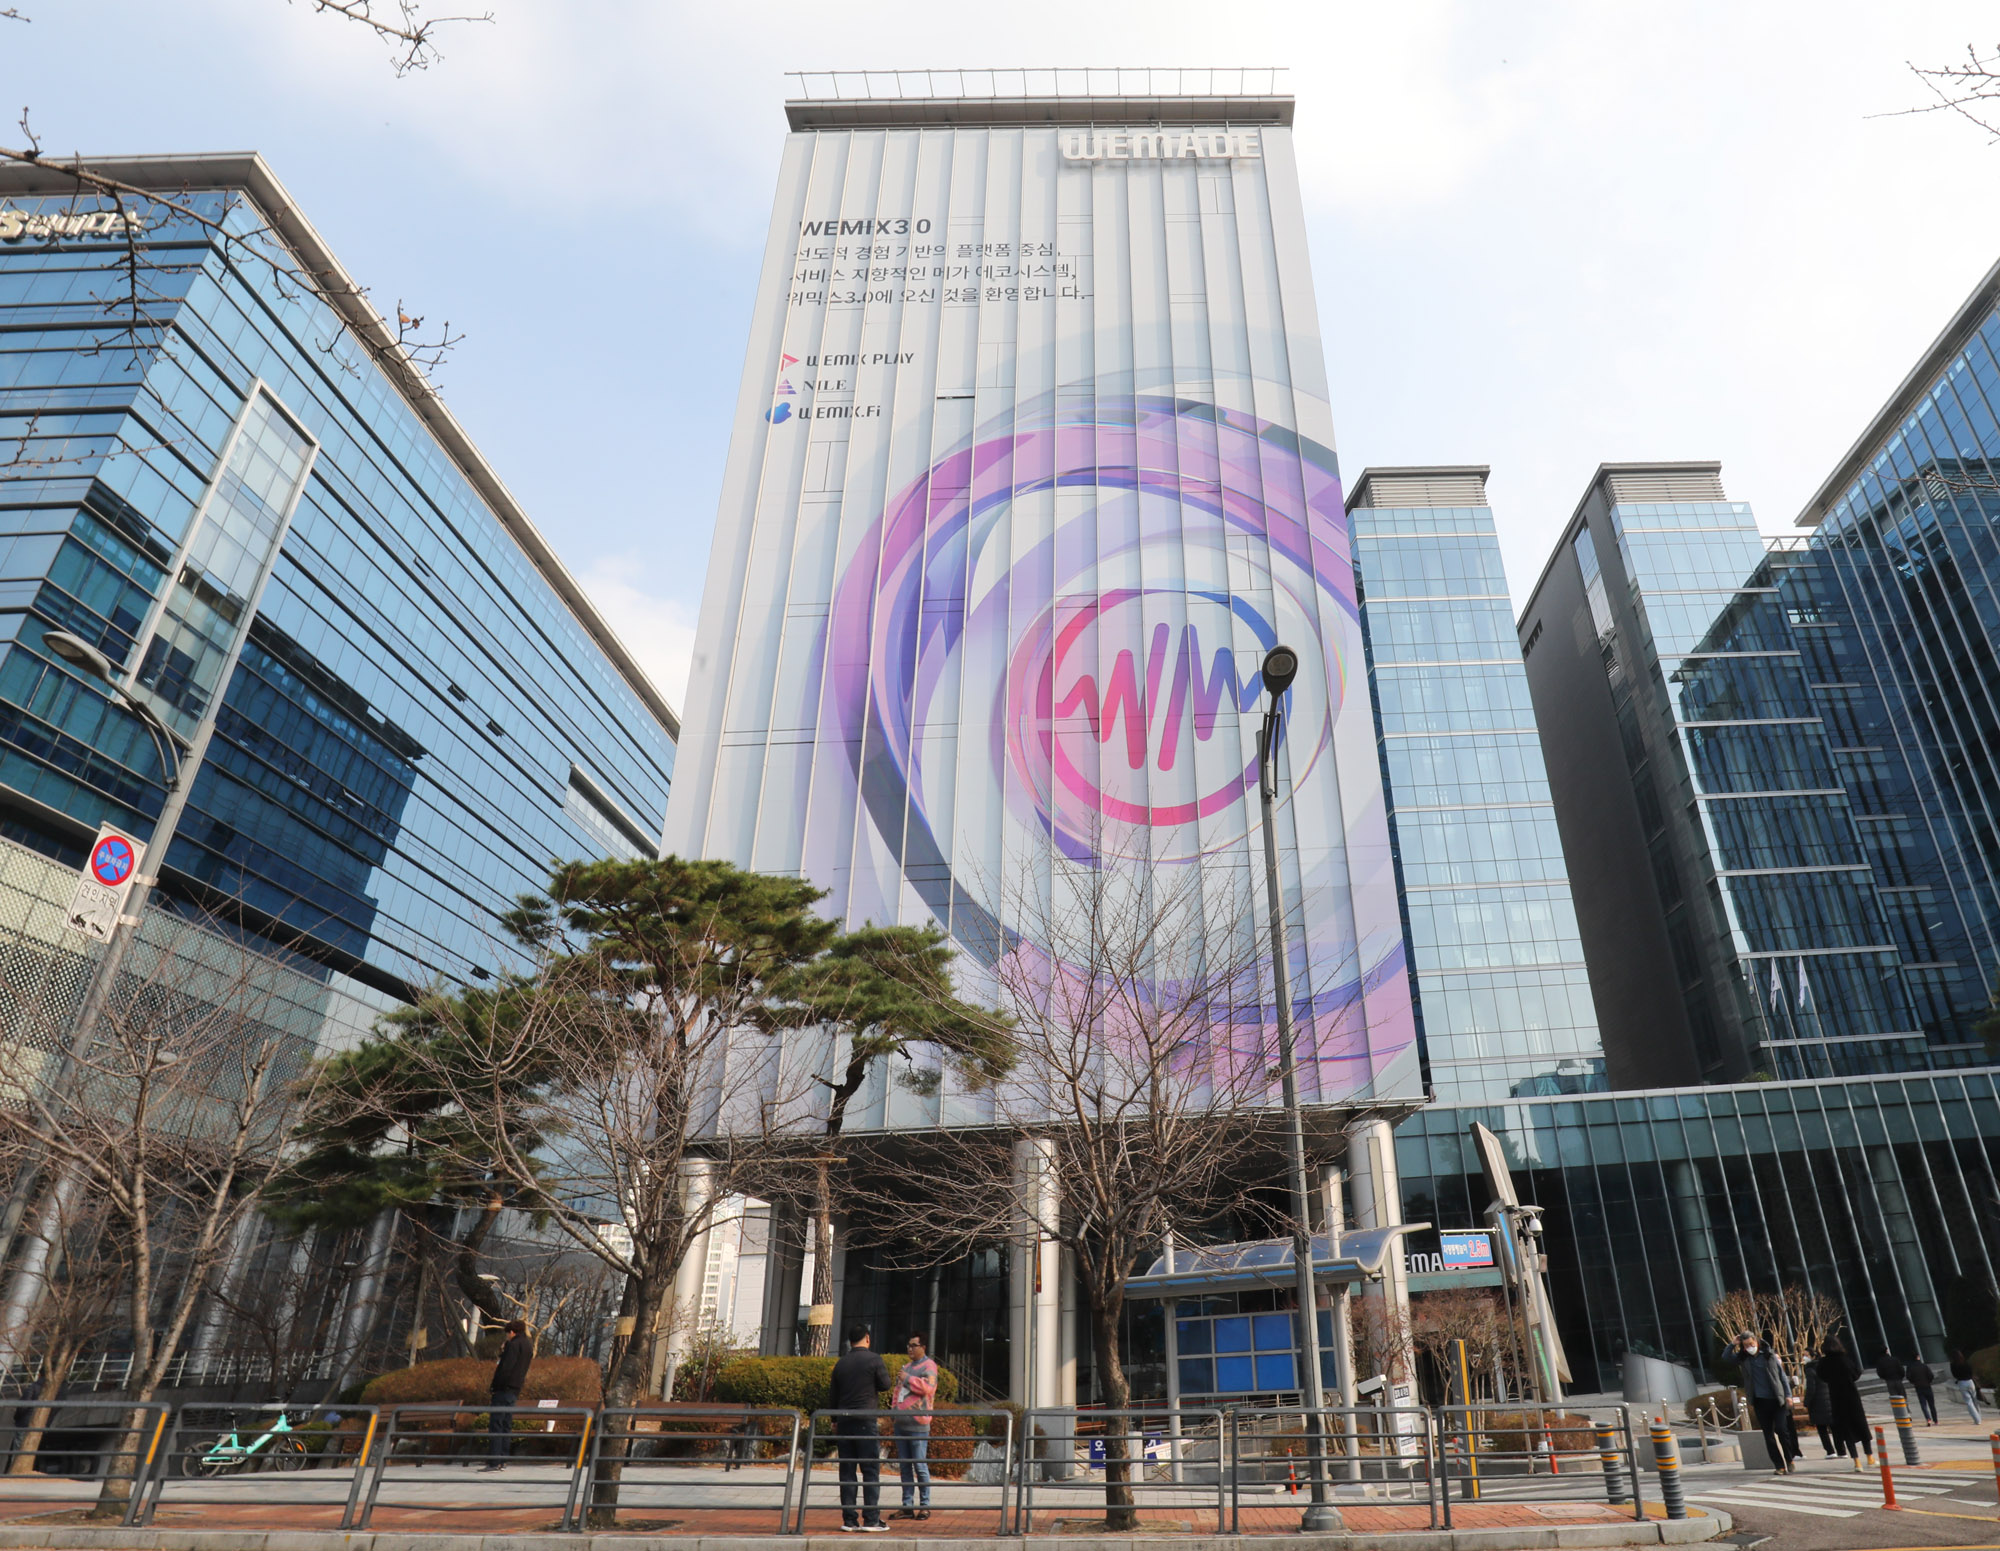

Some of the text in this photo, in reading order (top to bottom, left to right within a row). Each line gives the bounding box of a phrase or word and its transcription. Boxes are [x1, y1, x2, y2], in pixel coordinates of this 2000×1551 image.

[1062, 132, 1261, 160] WEMADE
[793, 246, 848, 262] 선도적
[855, 245, 890, 260] 경험
[957, 243, 1012, 258] 플랫폼
[789, 268, 845, 283] 서비스
[851, 266, 926, 282] 지향적인
[933, 265, 970, 280] 메가
[785, 286, 1086, 306] 위믹스3.0에 오신 것을 환영합니다.
[806, 353, 915, 367] WEMIX PLAY
[802, 380, 847, 391] NILE
[799, 405, 881, 420] WEMIX.Fi
[81, 884, 117, 909] 견인지역
